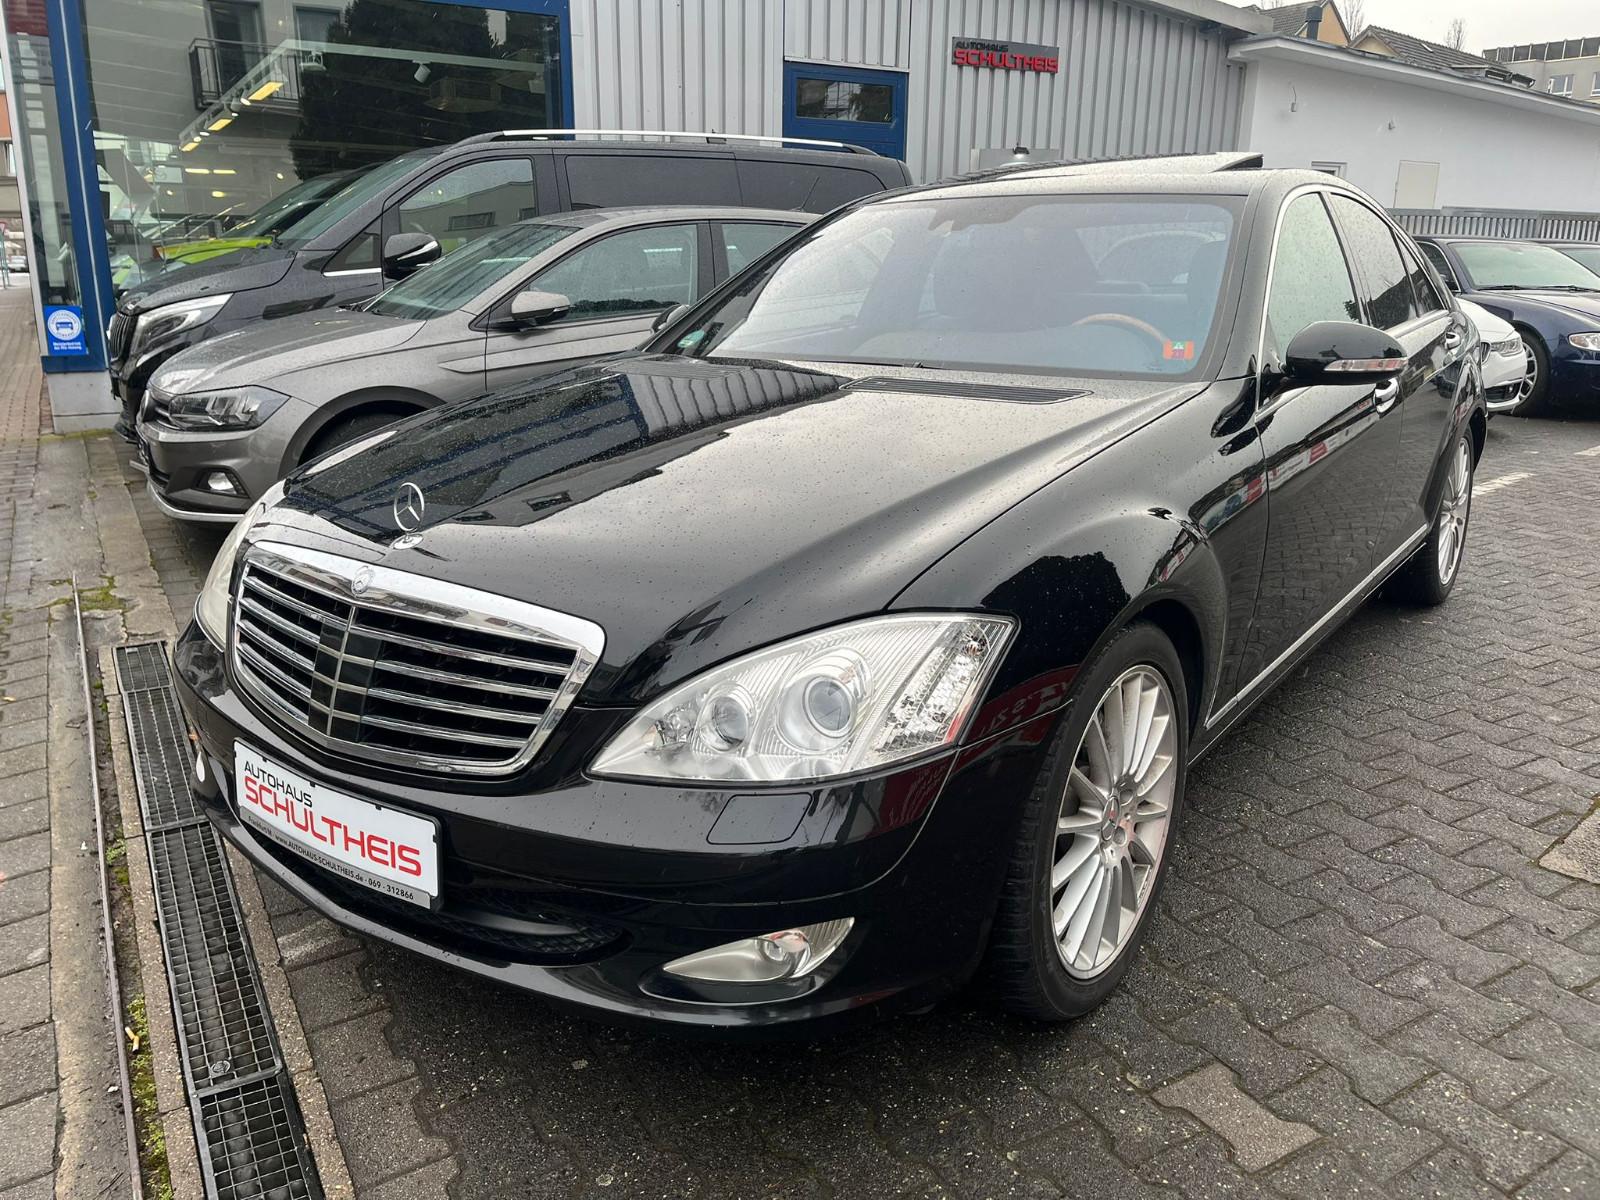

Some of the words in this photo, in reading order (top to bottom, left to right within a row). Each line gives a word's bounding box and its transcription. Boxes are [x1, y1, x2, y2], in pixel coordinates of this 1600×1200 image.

[955, 41, 1008, 52] AUTOHAUS
[954, 48, 1059, 73] SCHULTHEIS
[244, 761, 313, 808] AUTOHAUS
[244, 775, 421, 877] SCHULTHEIS
[368, 878, 381, 889] 069
[386, 885, 414, 900] 312866
